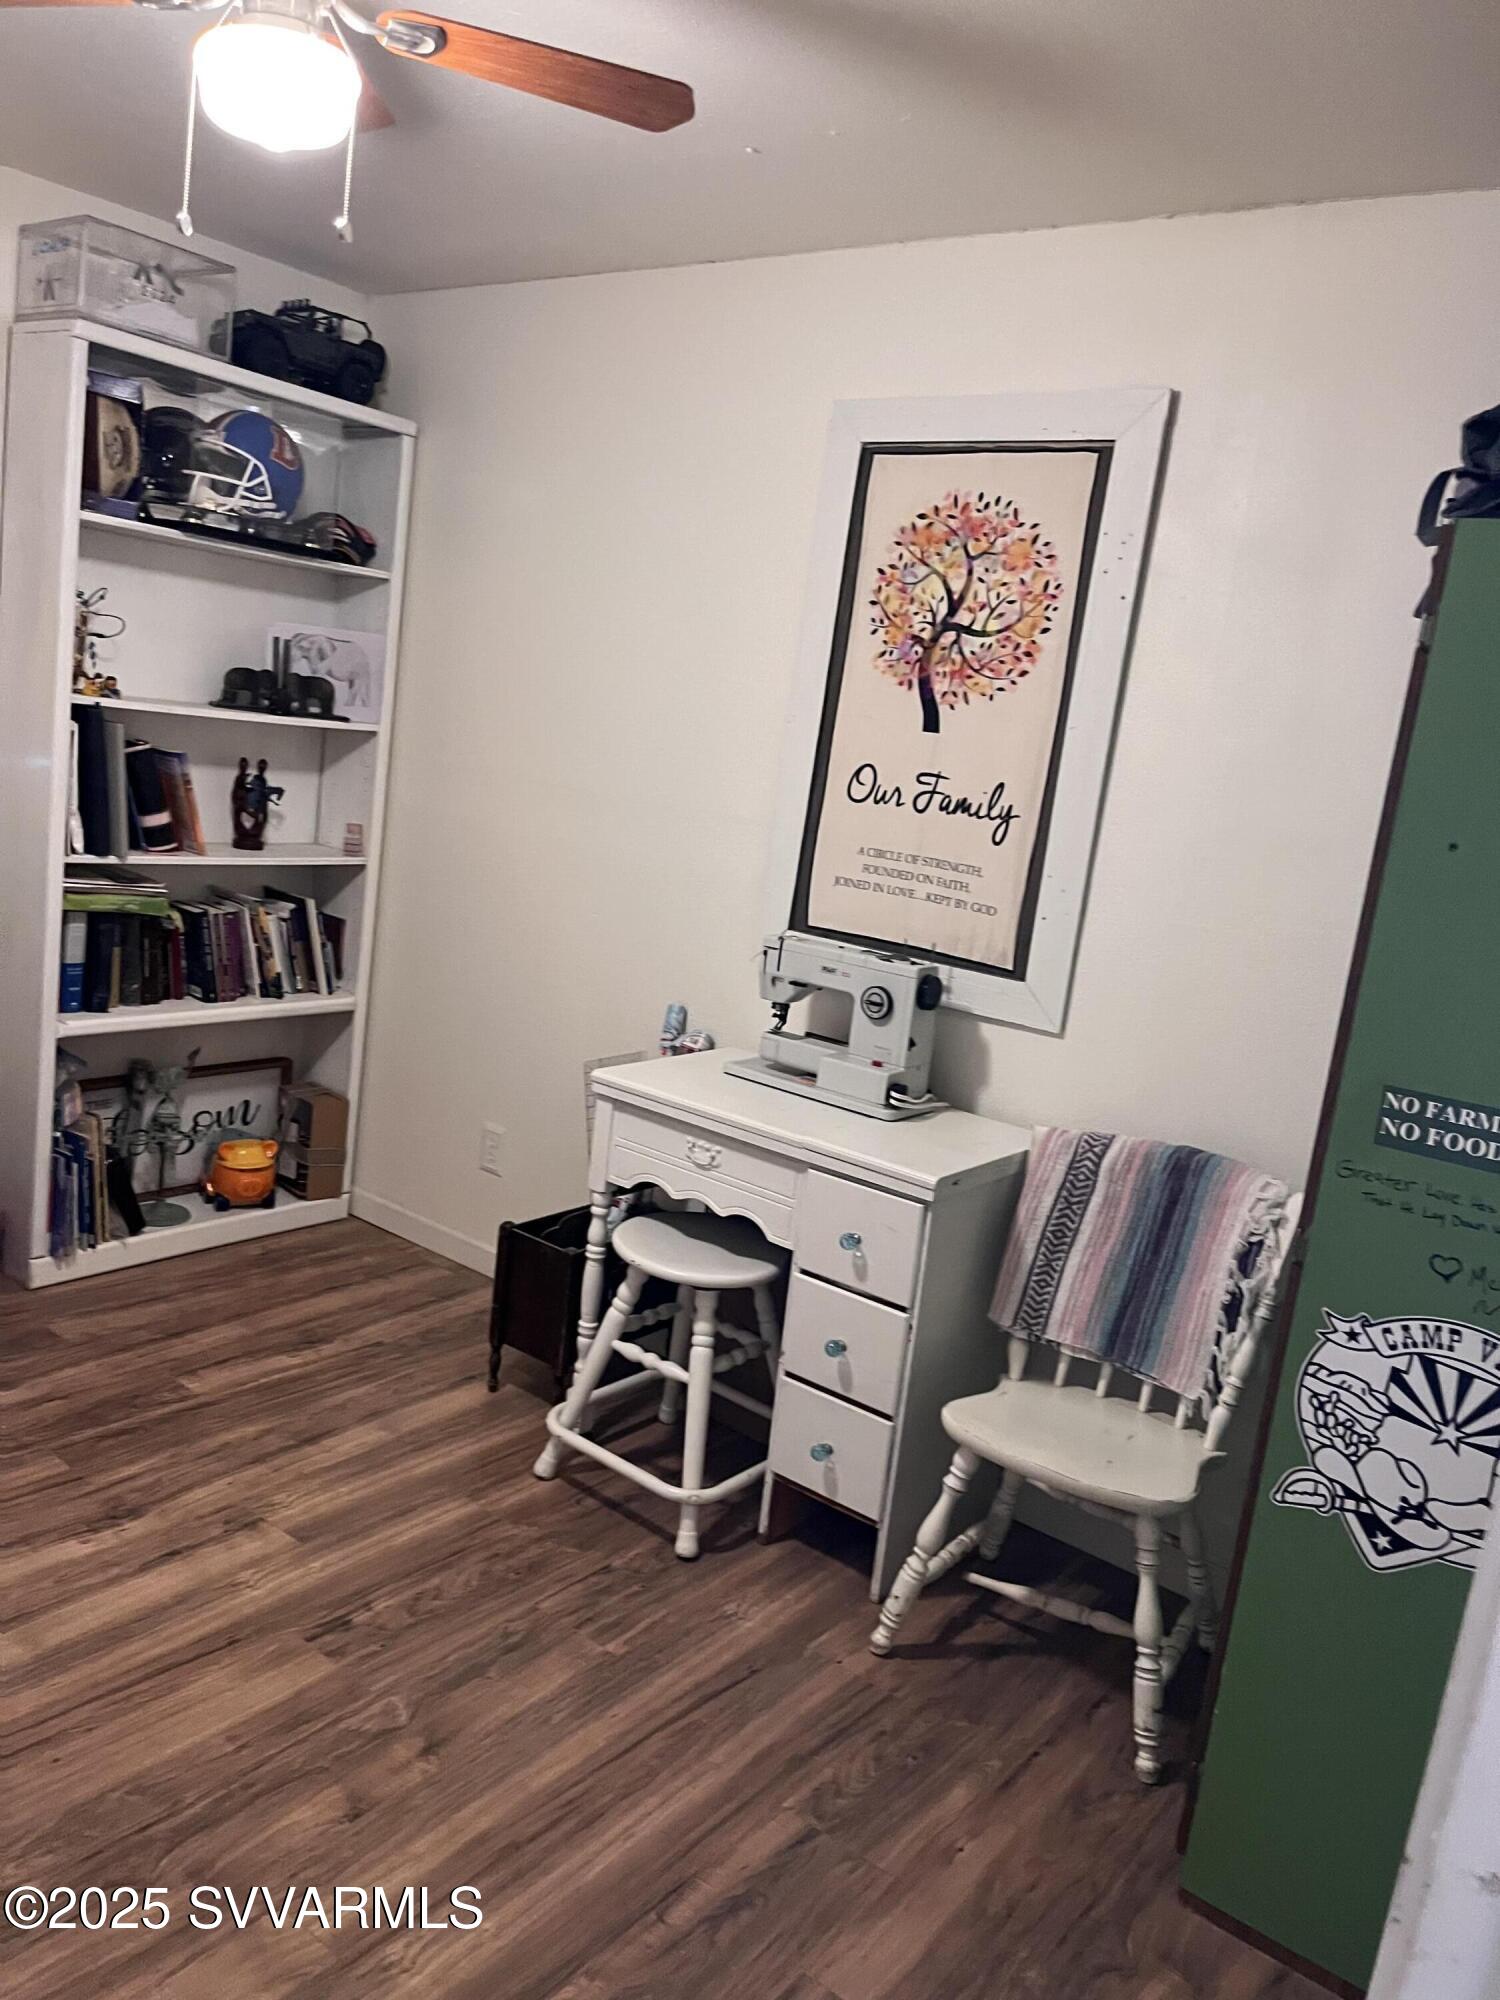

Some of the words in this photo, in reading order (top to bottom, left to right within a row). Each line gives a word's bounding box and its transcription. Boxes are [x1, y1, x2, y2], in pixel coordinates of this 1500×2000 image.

[847, 763, 905, 808] Our
[912, 771, 1021, 846] Family
[857, 847, 865, 856] A
[866, 847, 903, 862] CIRCLE
[904, 853, 921, 866] OF
[861, 863, 915, 881] FOUNDED
[916, 873, 935, 885] ON
[832, 875, 871, 891] JOINED
[873, 883, 885, 893] IN
[954, 898, 969, 911] BY
[969, 902, 998, 917] GOD
[1383, 1091, 1421, 1114] NO
[1379, 1116, 1421, 1141] NO
[1381, 1323, 1463, 1353] CAMP
